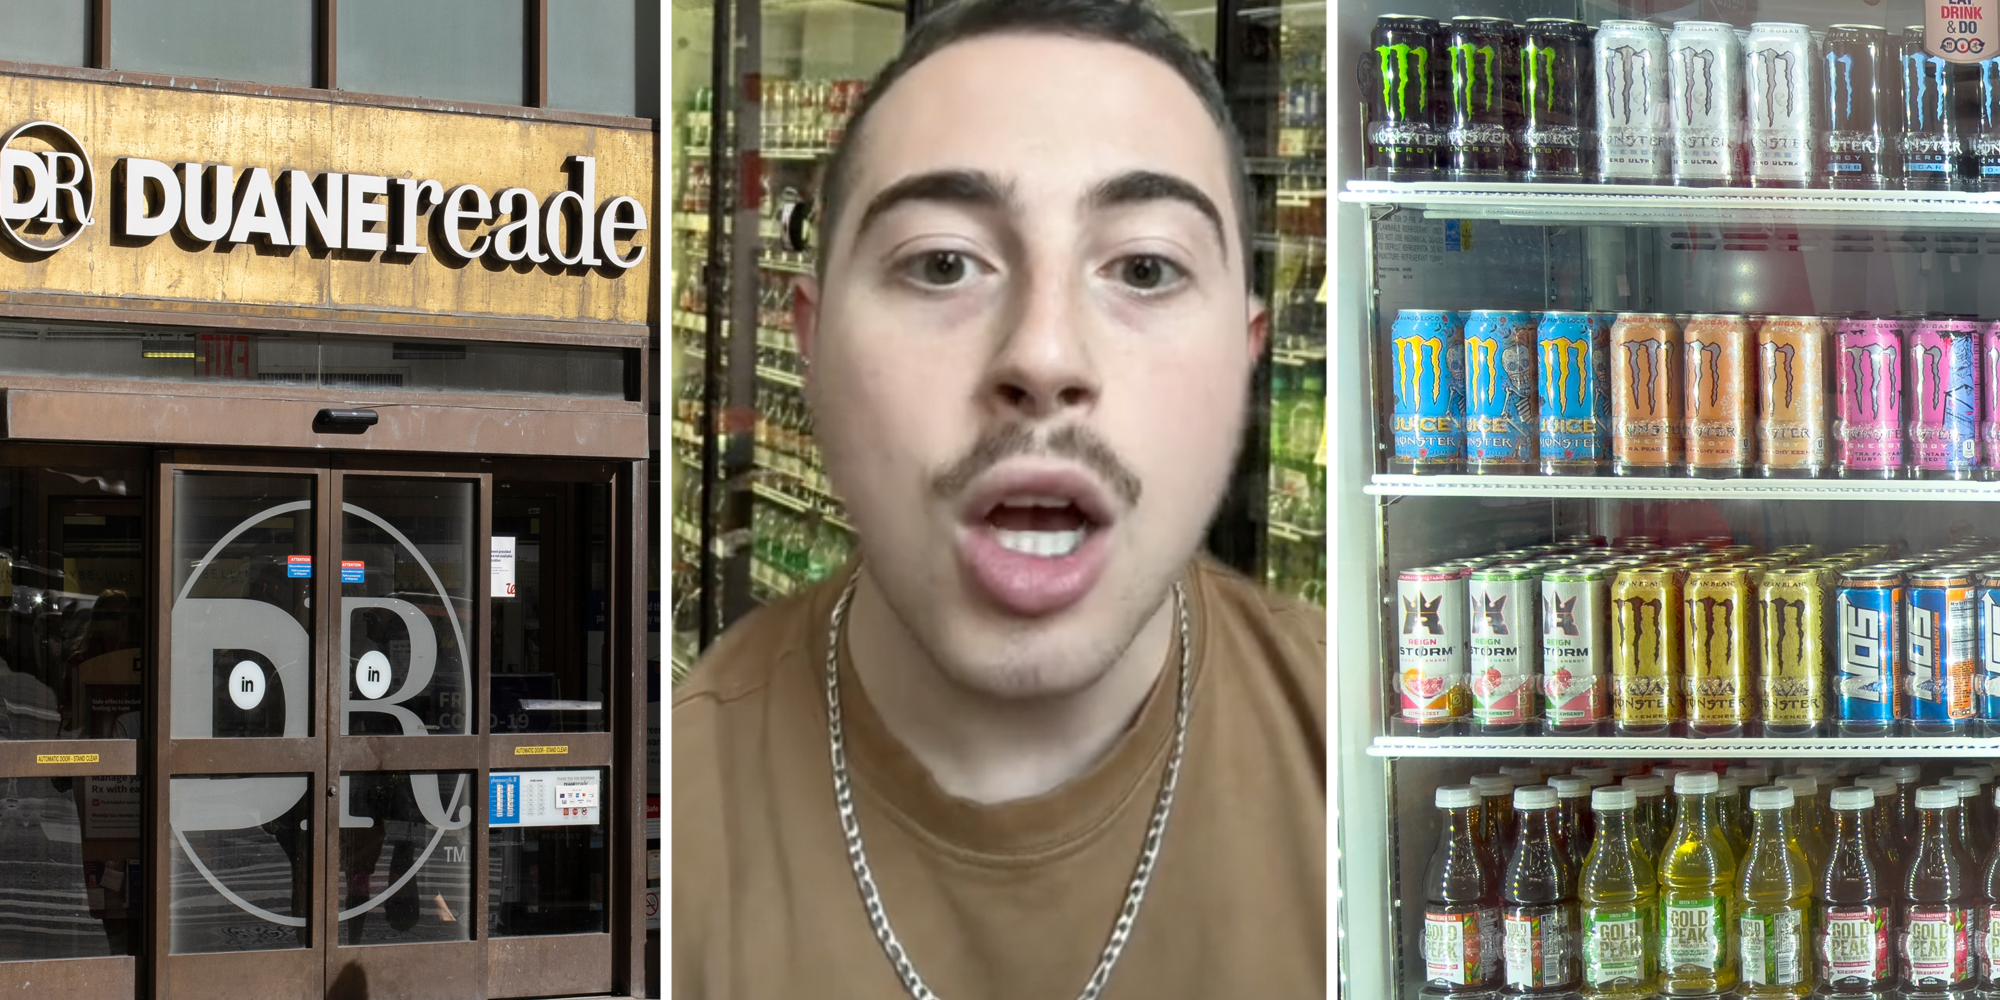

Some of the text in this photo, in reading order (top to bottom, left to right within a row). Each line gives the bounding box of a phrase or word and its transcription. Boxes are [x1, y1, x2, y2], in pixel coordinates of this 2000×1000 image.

[1941, 6, 1983, 20] DRINK
[1947, 21, 1977, 34] & DO
[65, 570, 136, 581] YBELLINE
[1837, 592, 1880, 702] NOS
[368, 666, 380, 682] in
[242, 676, 254, 692] in
[1763, 698, 1820, 711] ONSTER
[92, 785, 103, 793] Rx
[106, 785, 127, 793] with
[444, 846, 466, 862] TM
[1671, 910, 1708, 928] GOLD
[1600, 922, 1638, 939] GOLD
[1672, 928, 1708, 945] PEAK
[1832, 921, 1870, 938] GOLD
[1912, 922, 1948, 940] GOLD
[1832, 939, 1870, 956] PEAK
